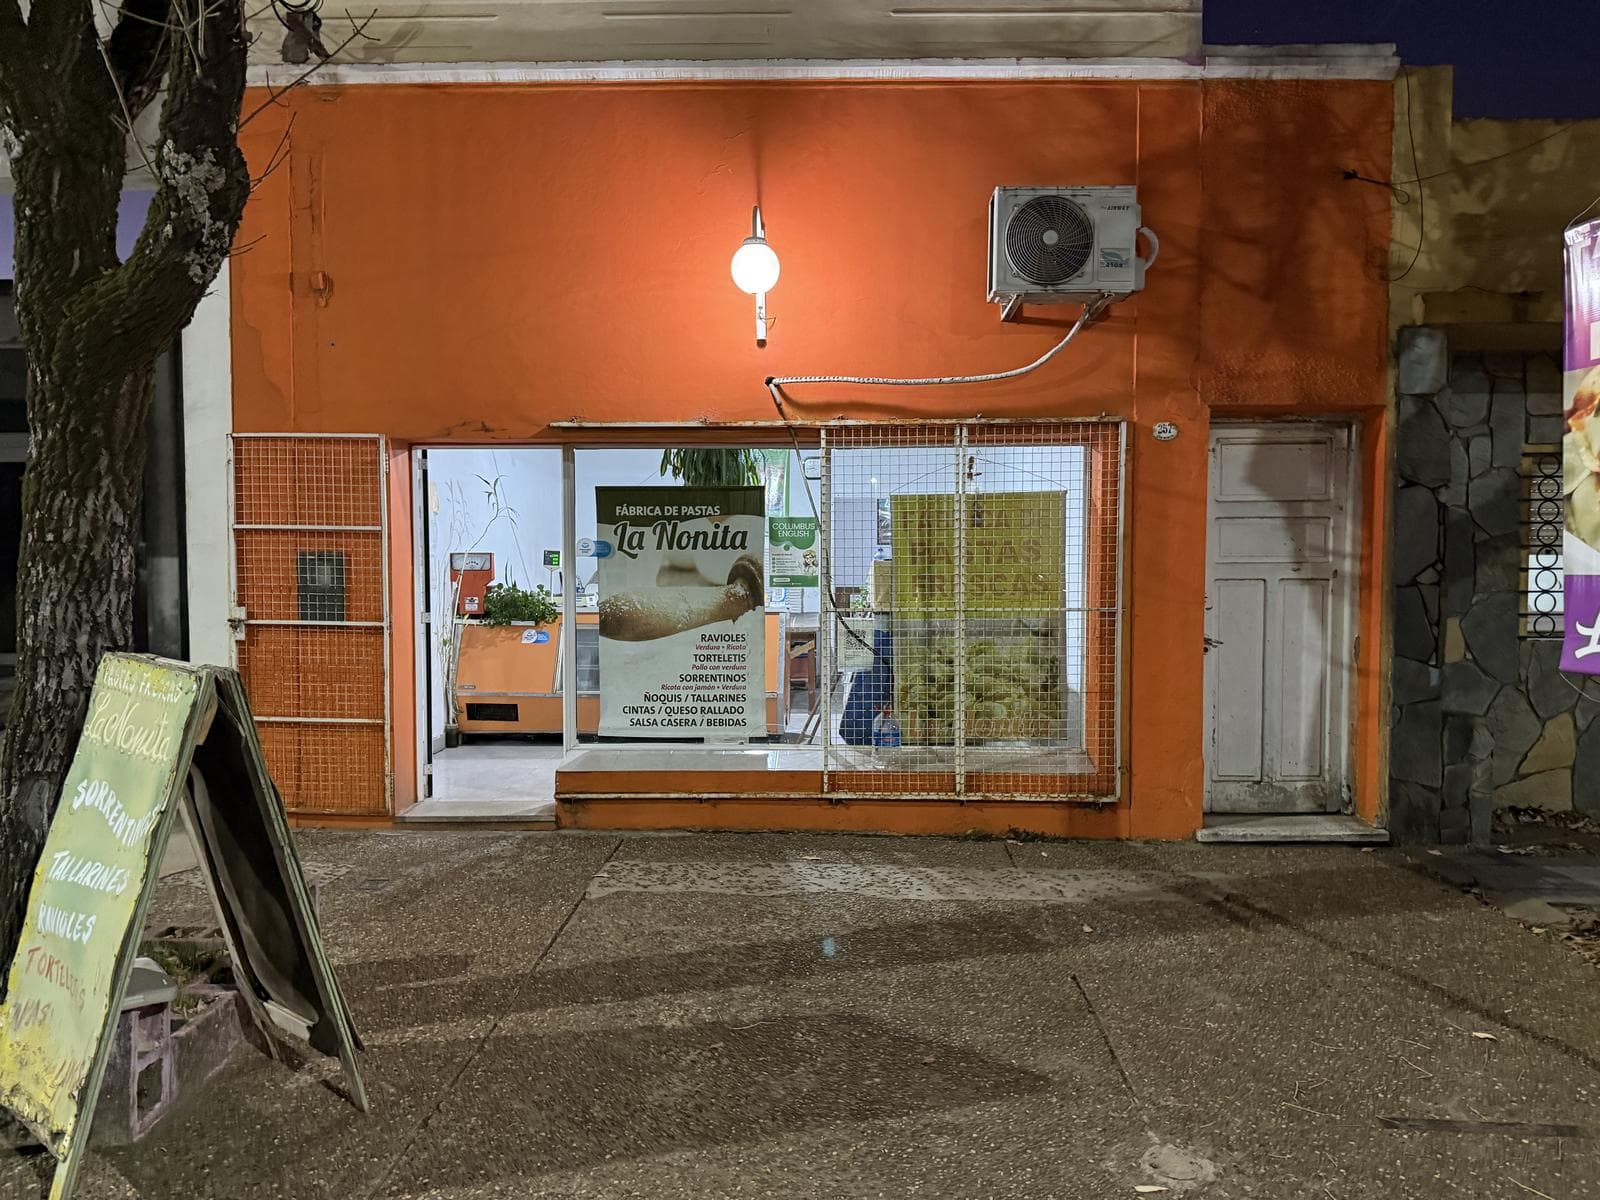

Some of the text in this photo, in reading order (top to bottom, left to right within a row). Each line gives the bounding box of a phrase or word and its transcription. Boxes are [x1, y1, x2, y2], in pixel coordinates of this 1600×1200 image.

[615, 503, 721, 517] FÁBRICA DE PASTAS
[772, 522, 815, 530] COLUMBUS
[613, 520, 749, 560] La Nonita
[700, 633, 746, 643] RAVIOLES
[695, 643, 747, 651] Verdura Ricota
[693, 653, 746, 663] TORTELETIS
[679, 673, 747, 683] SORRENTINOS
[694, 684, 716, 692] jamón
[643, 691, 682, 705] ÑOQUIS
[690, 694, 747, 703] TALLARINES
[622, 706, 656, 715] CINTAS
[664, 706, 698, 717] QUESO
[700, 706, 745, 715] RALLADO
[629, 718, 658, 727] SALSA
[660, 718, 698, 727] CASERA
[706, 718, 747, 727] BEBIDAS
[49, 850, 129, 895] TALLARINES
[38, 903, 97, 945] RAVIOLES
